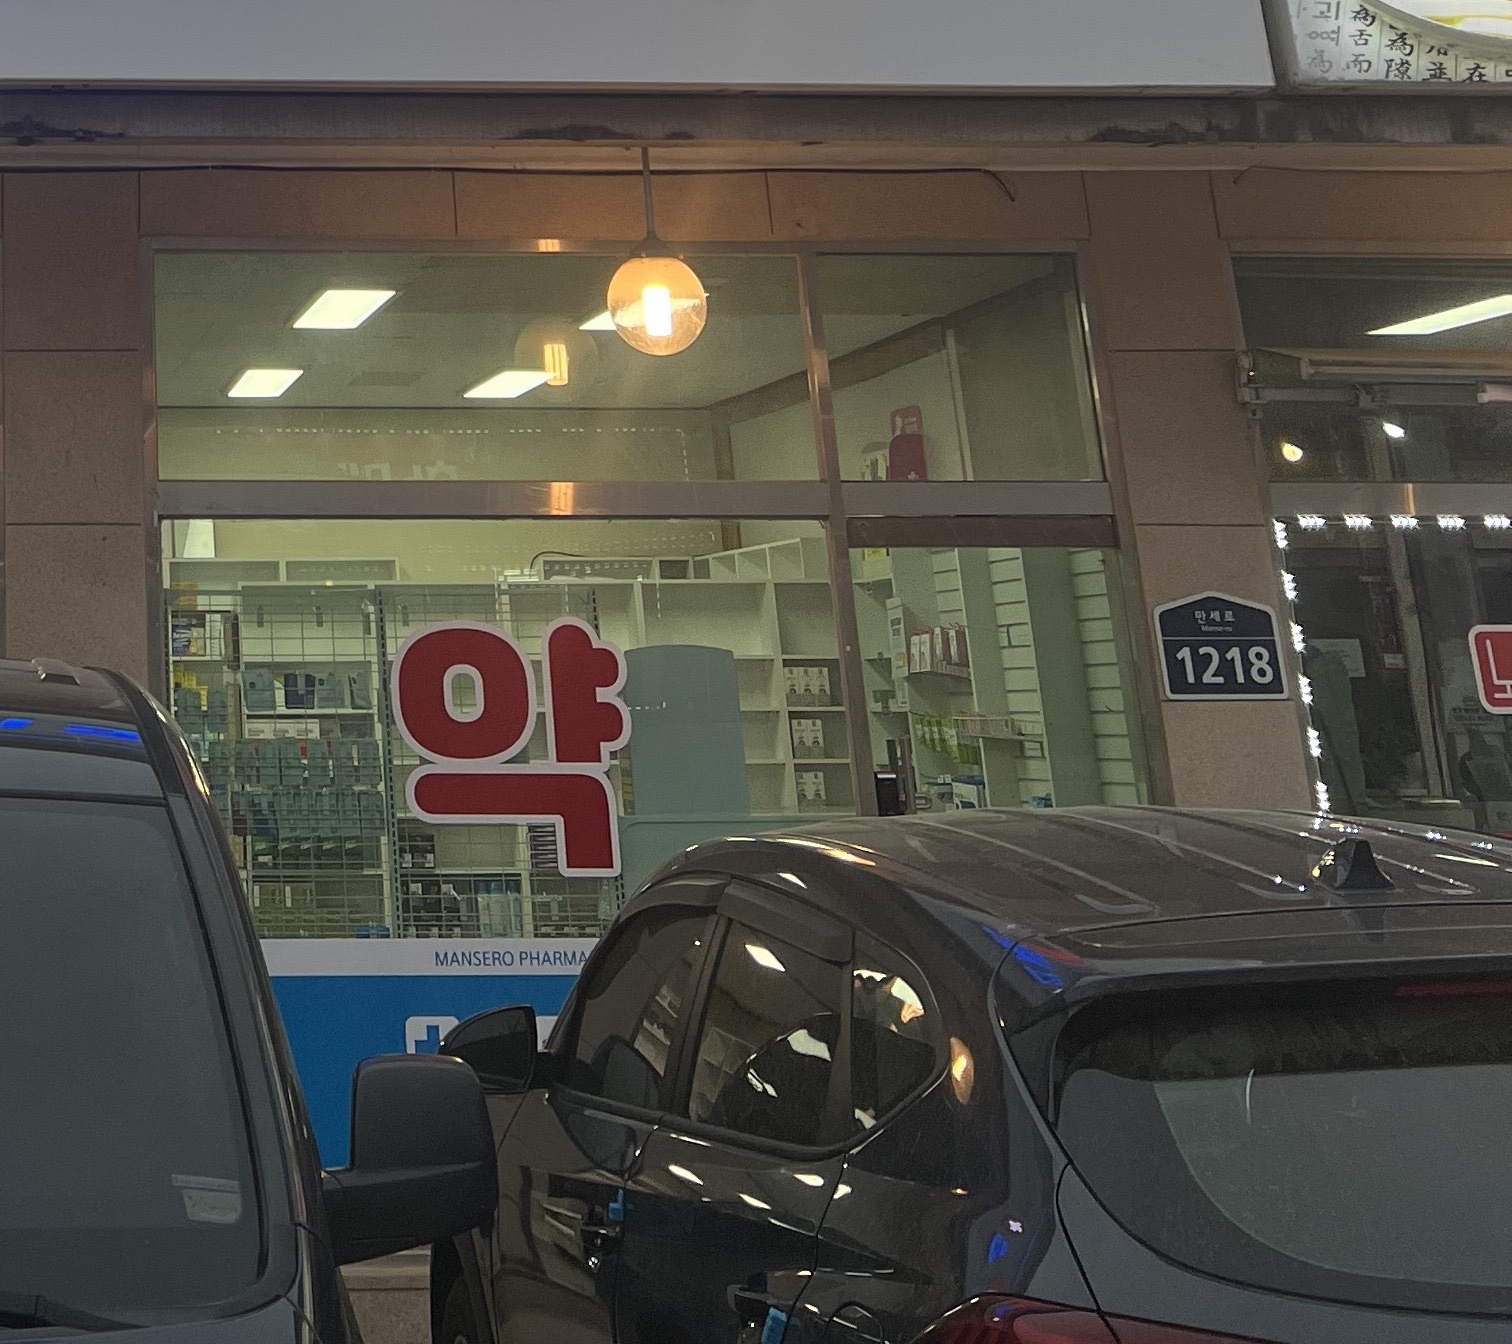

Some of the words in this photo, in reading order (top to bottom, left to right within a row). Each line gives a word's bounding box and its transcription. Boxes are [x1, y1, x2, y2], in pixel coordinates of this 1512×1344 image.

[1175, 646, 1274, 684] 1218
[395, 620, 627, 872] 약
[434, 950, 515, 967] MANSERO
